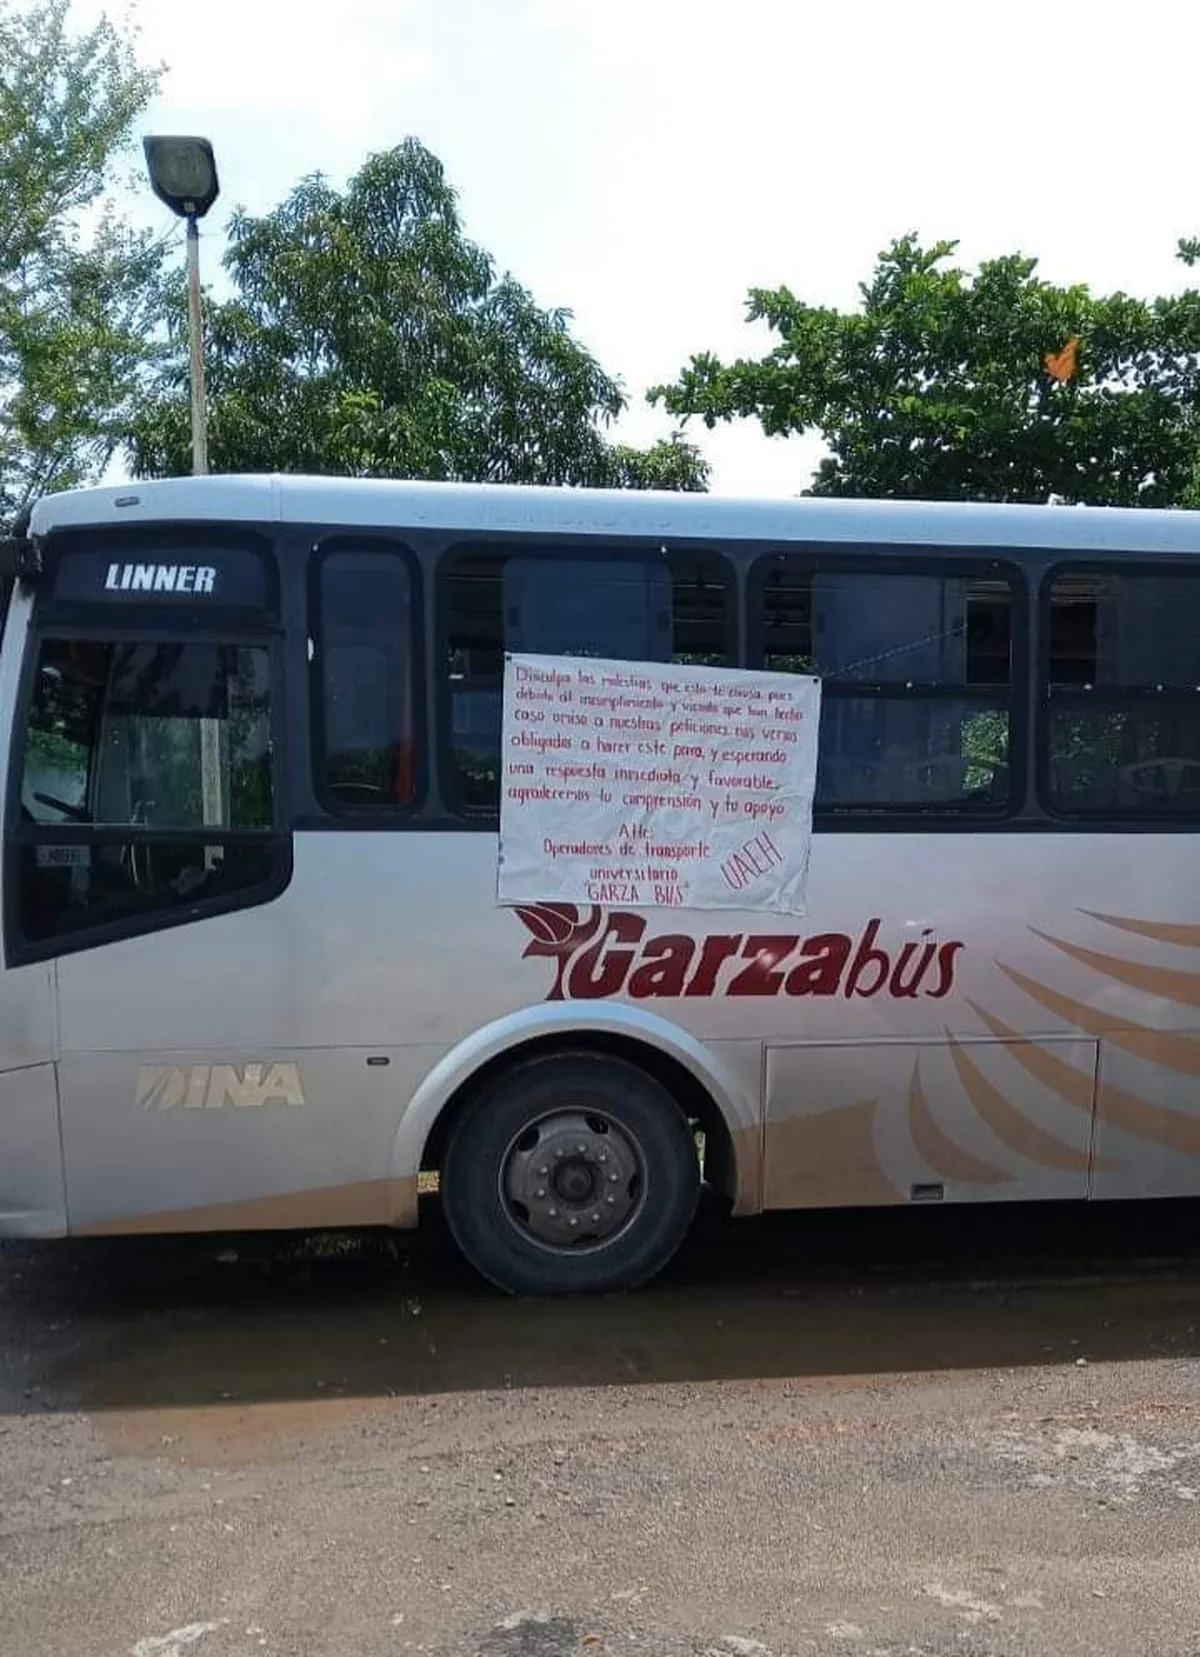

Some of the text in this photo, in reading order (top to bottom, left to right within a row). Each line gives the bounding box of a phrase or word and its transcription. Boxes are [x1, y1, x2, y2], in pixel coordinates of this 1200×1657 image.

[104, 563, 216, 592] LINNER
[515, 666, 571, 687] Disculpa
[578, 669, 596, 685] las
[514, 708, 545, 723] caso
[552, 710, 588, 726] omiso
[594, 717, 603, 727] a
[610, 715, 661, 732] nuestras
[723, 706, 743, 718] que
[581, 740, 590, 750] a
[597, 737, 630, 753] hacer
[638, 740, 667, 755] este
[709, 748, 719, 763] y
[722, 748, 787, 767] esperando
[509, 764, 534, 775] una
[546, 762, 606, 782] respuesta
[691, 775, 699, 790] y
[709, 799, 720, 819] y
[726, 794, 738, 813] tu
[744, 801, 785, 820] apoyo
[543, 838, 711, 860] Operadores de transporte
[720, 830, 784, 890] UAEH
[590, 866, 678, 881] universitario
[568, 910, 965, 999] Garzabús
[134, 1062, 306, 1111] DINA
